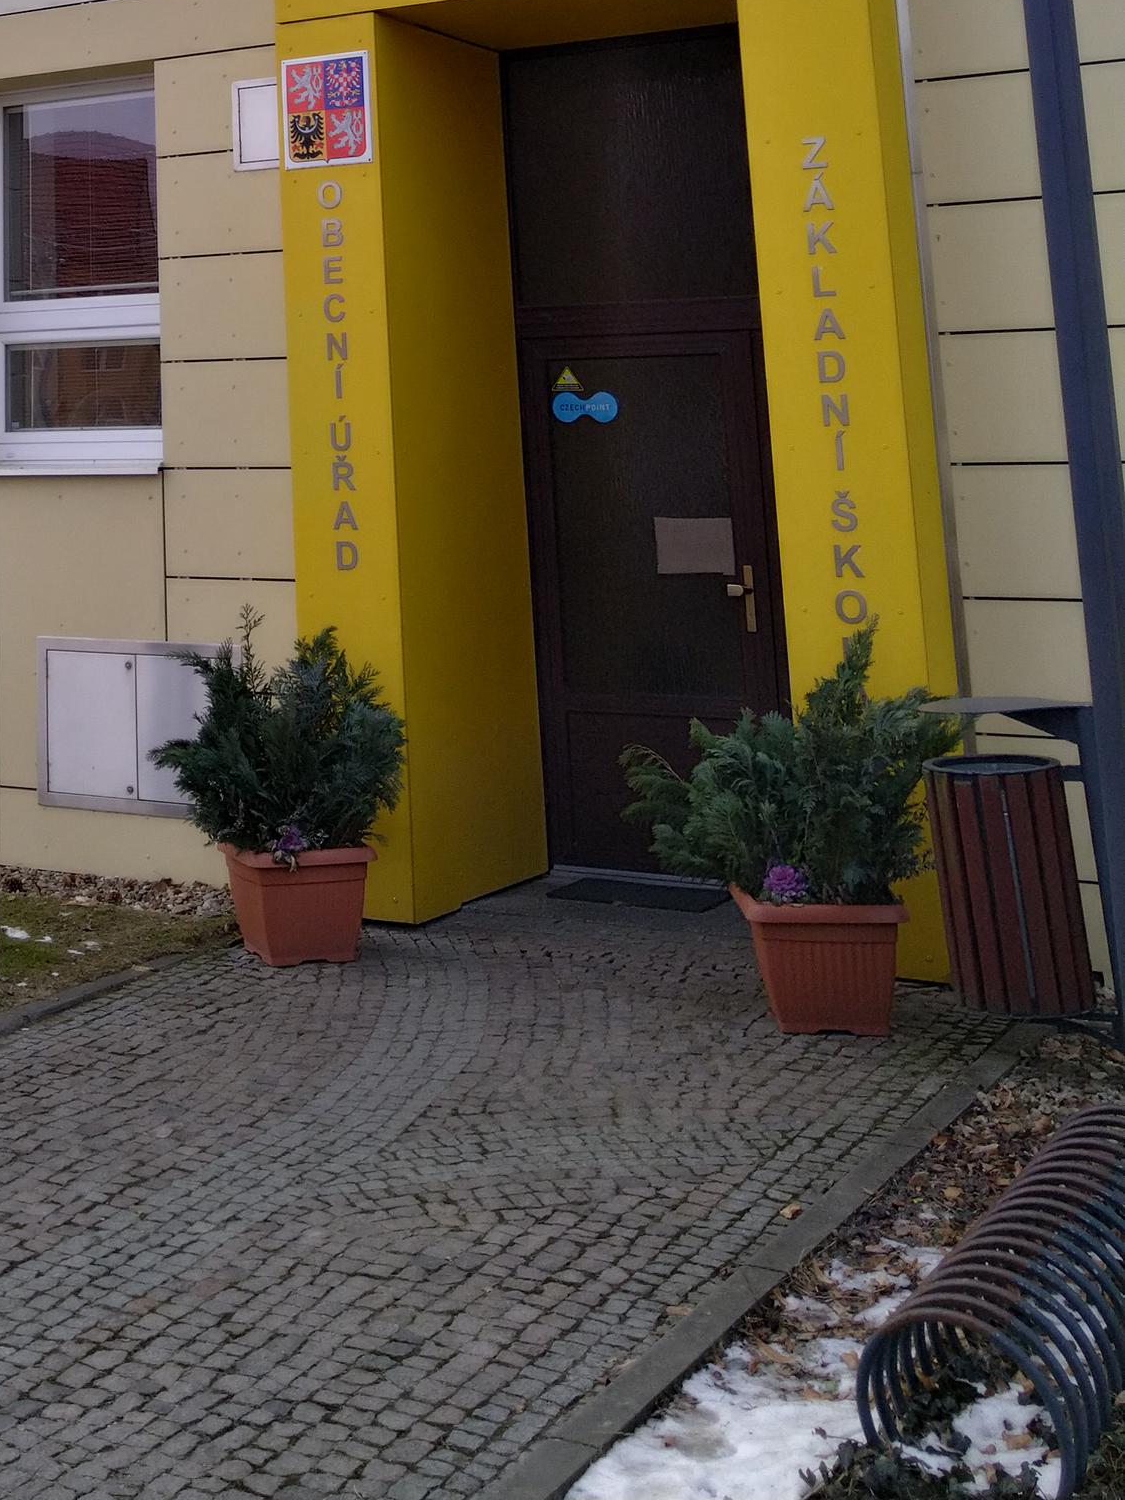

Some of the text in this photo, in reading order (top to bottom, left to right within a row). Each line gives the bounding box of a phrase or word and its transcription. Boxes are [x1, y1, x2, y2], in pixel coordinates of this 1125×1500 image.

[318, 180, 359, 571] OBECNÍ ÚŘAD
[802, 136, 872, 704] ZÁKLADNÍ ŠKO
